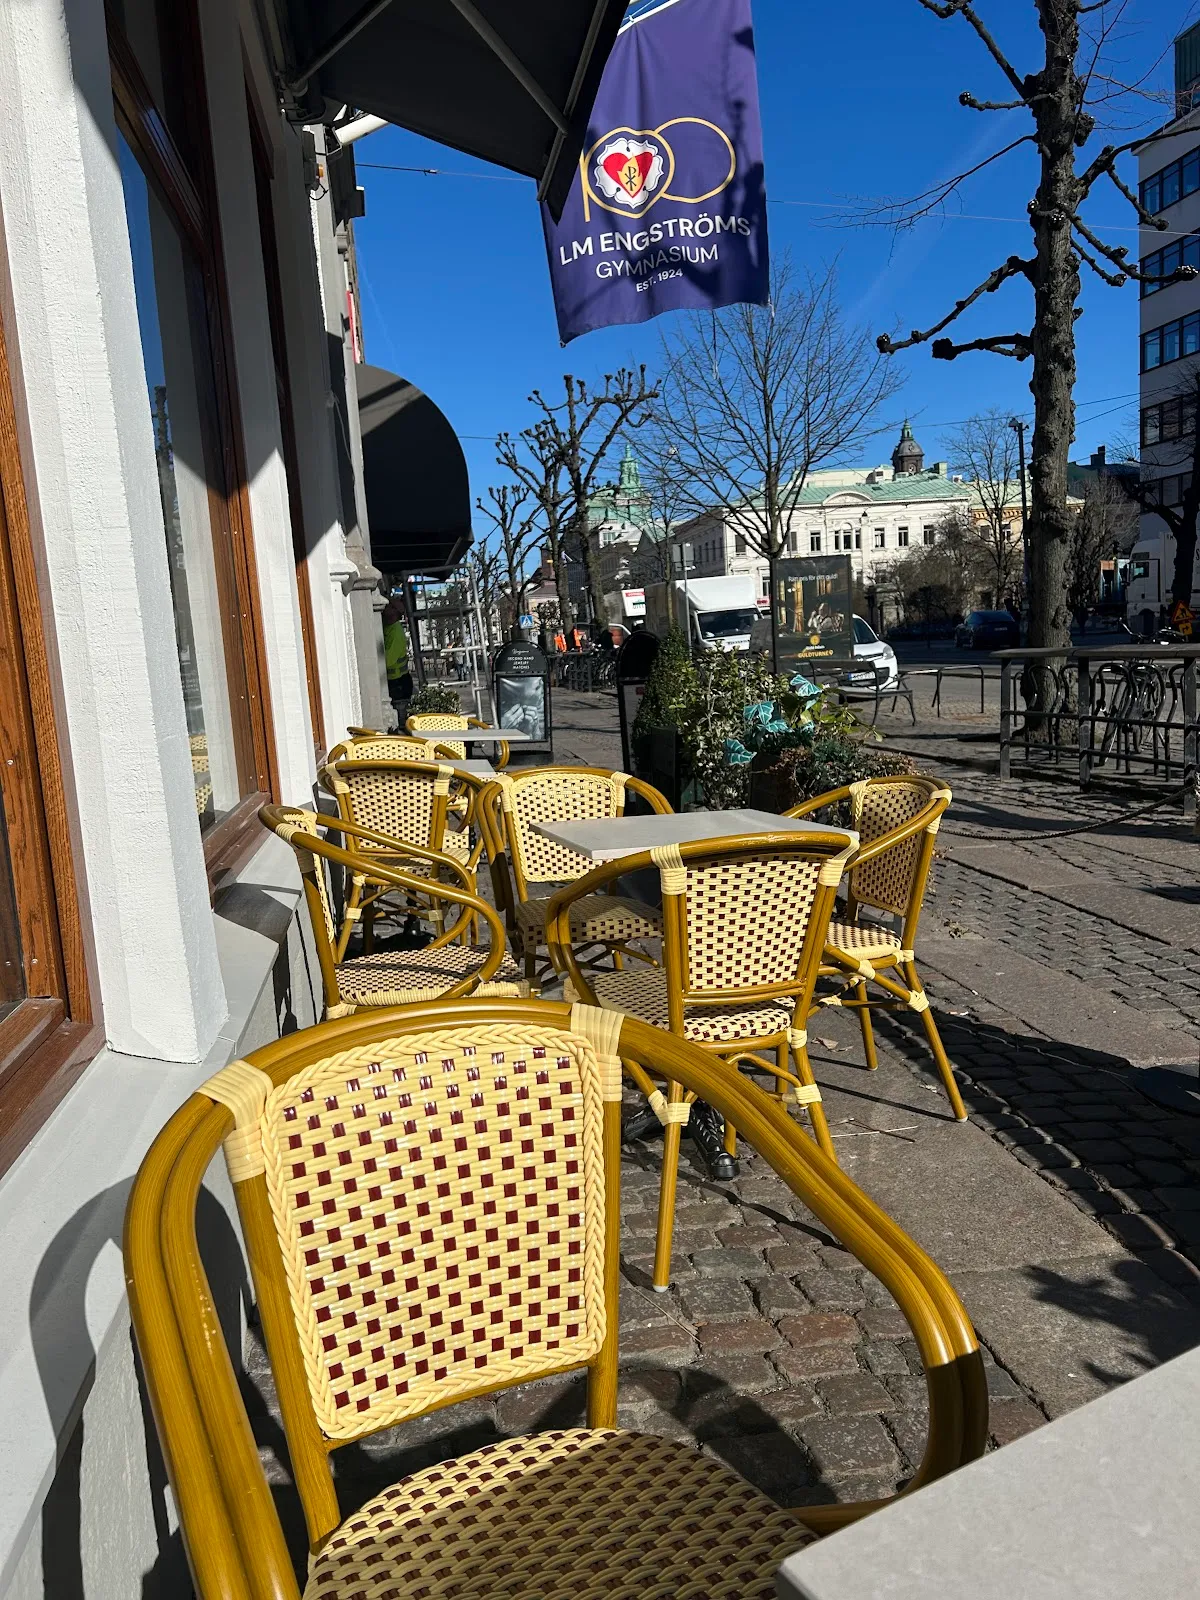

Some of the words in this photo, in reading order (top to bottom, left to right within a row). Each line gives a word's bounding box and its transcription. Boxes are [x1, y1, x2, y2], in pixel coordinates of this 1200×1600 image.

[559, 236, 594, 266] LM
[599, 212, 752, 253] ENGSTRÖMS
[595, 243, 719, 279] GYMNASIUM
[636, 278, 657, 293] EST.
[657, 267, 684, 282] 1924
